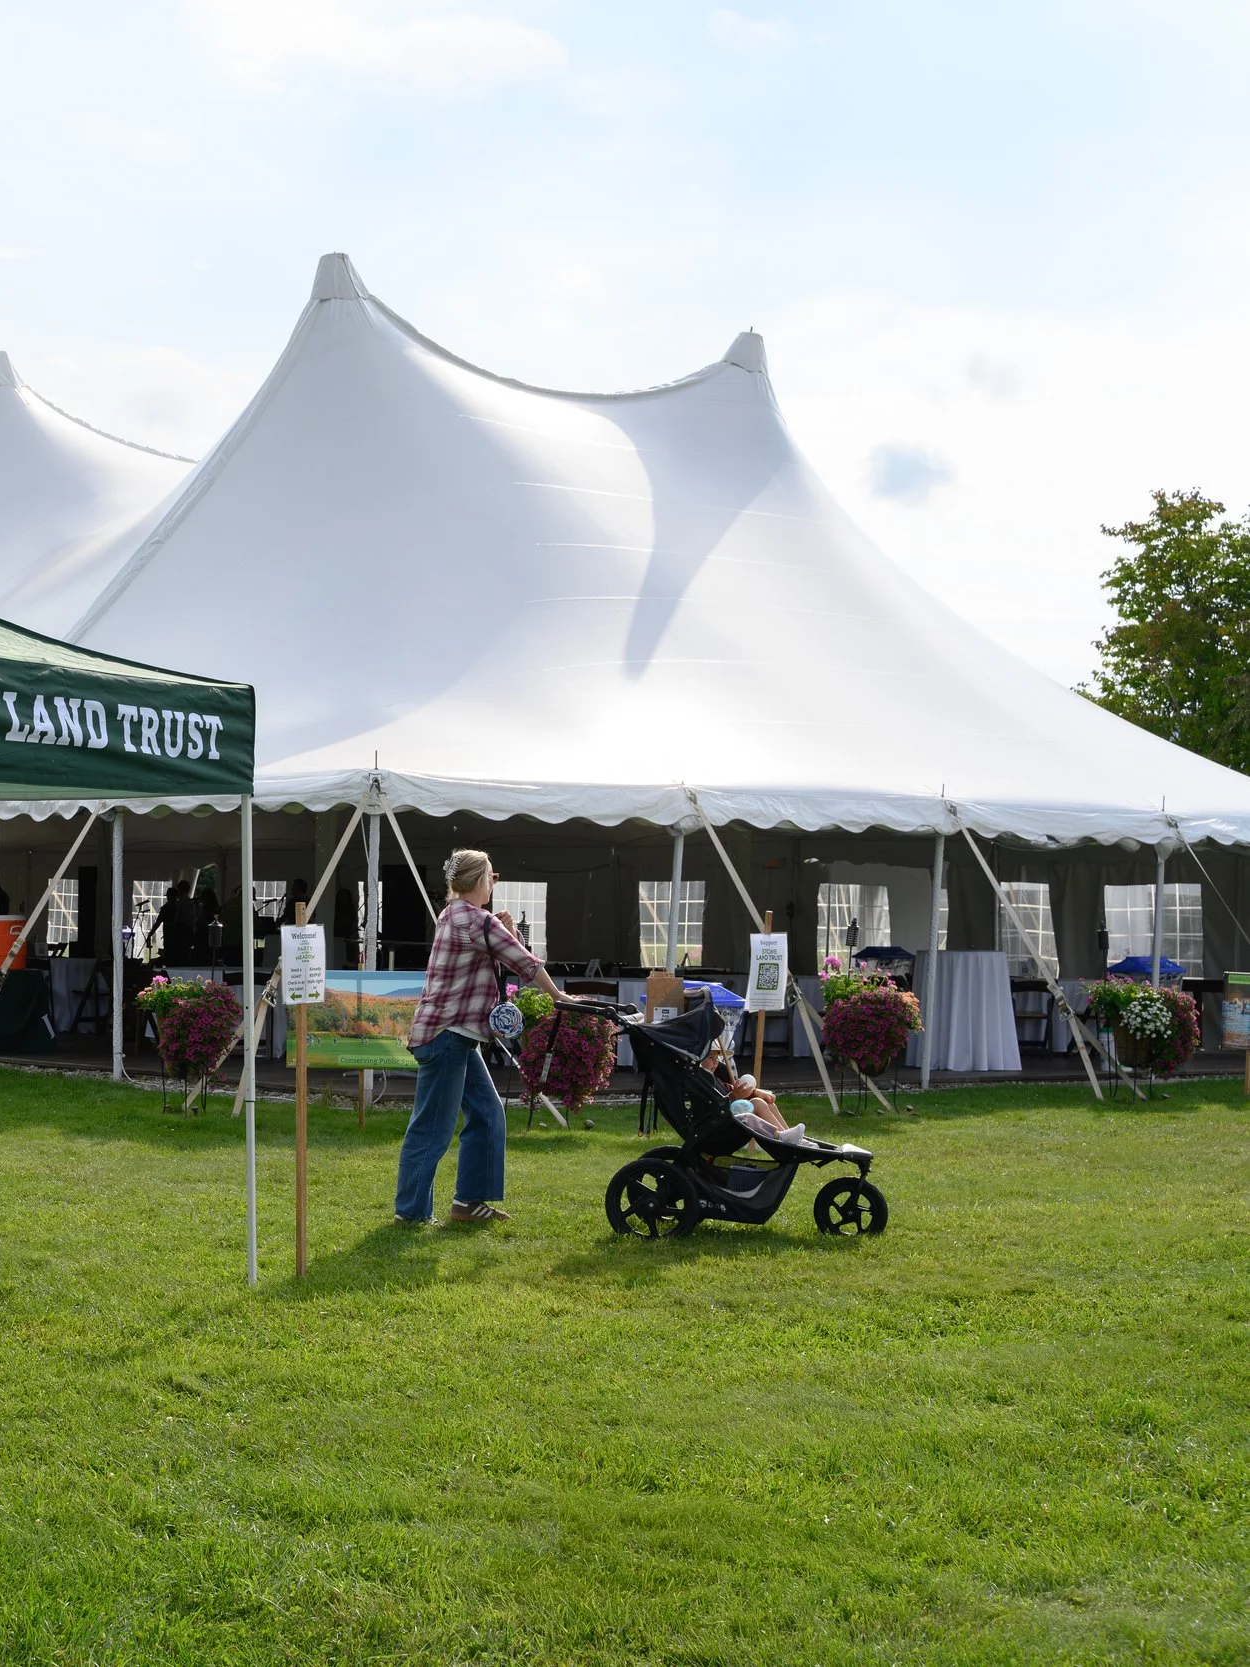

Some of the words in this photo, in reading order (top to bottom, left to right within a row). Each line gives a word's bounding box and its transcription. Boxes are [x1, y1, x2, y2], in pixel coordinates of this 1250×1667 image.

[3, 691, 109, 749] LAND
[117, 704, 224, 760] TRUST
[291, 932, 317, 940] Welcome!
[340, 1057, 378, 1065] Conserving
